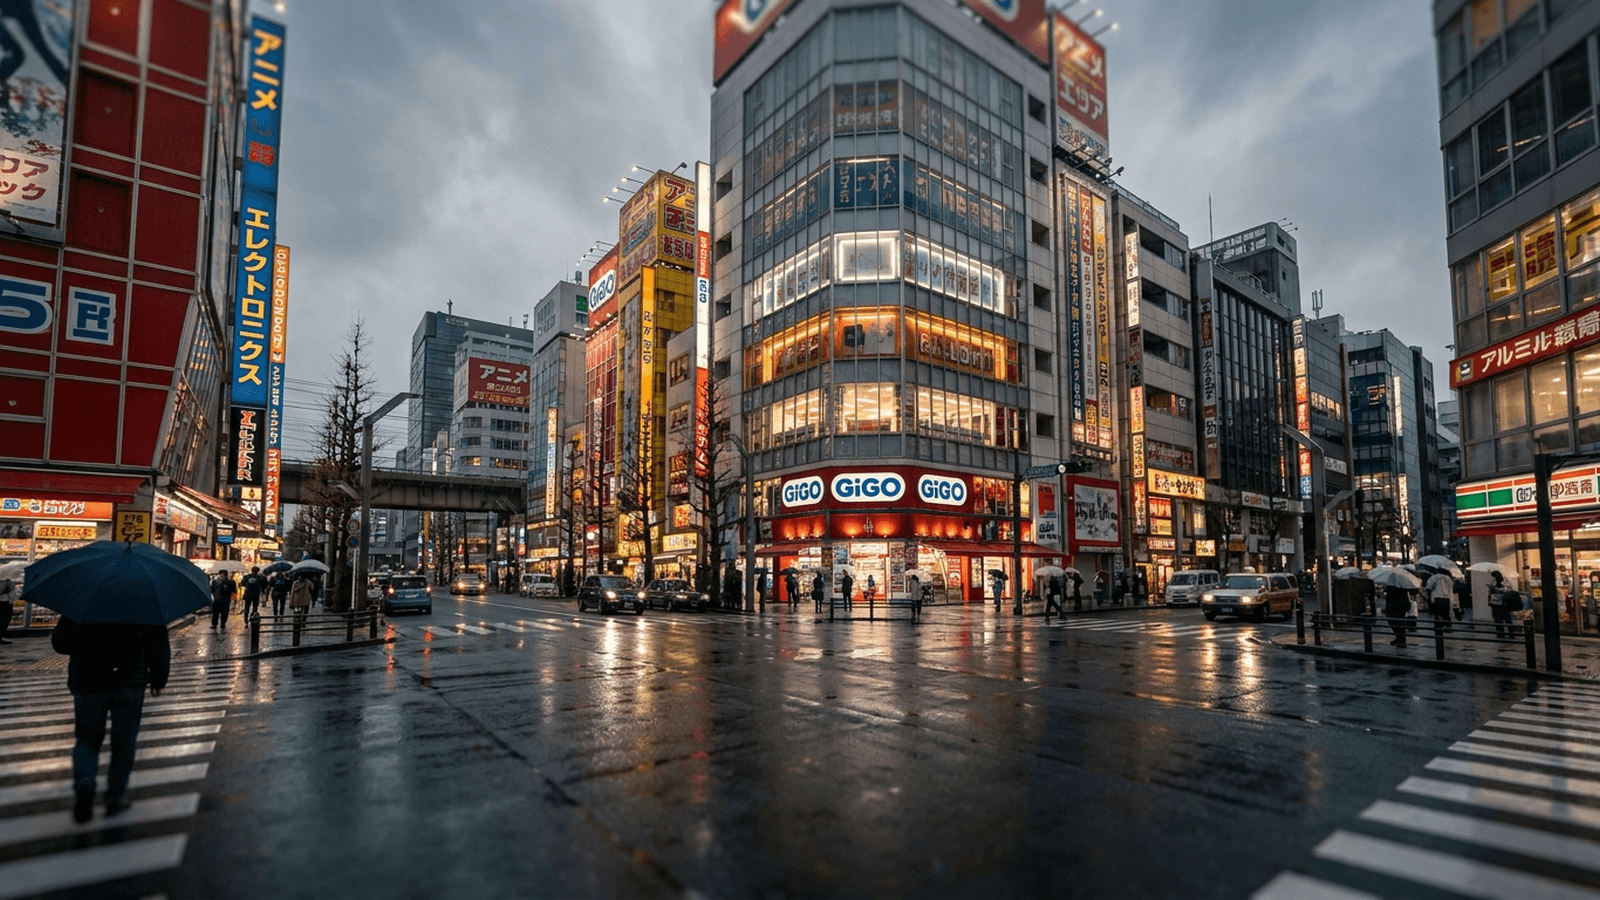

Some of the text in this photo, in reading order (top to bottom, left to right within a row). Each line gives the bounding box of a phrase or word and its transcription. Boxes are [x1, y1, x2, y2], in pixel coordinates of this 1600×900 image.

[251, 29, 282, 111] アニメ
[238, 207, 270, 386] エレクトロニクス
[480, 364, 528, 384] アニメ
[784, 480, 821, 503] GiGO
[835, 477, 902, 498] GiGO
[921, 479, 965, 502] GiGO
